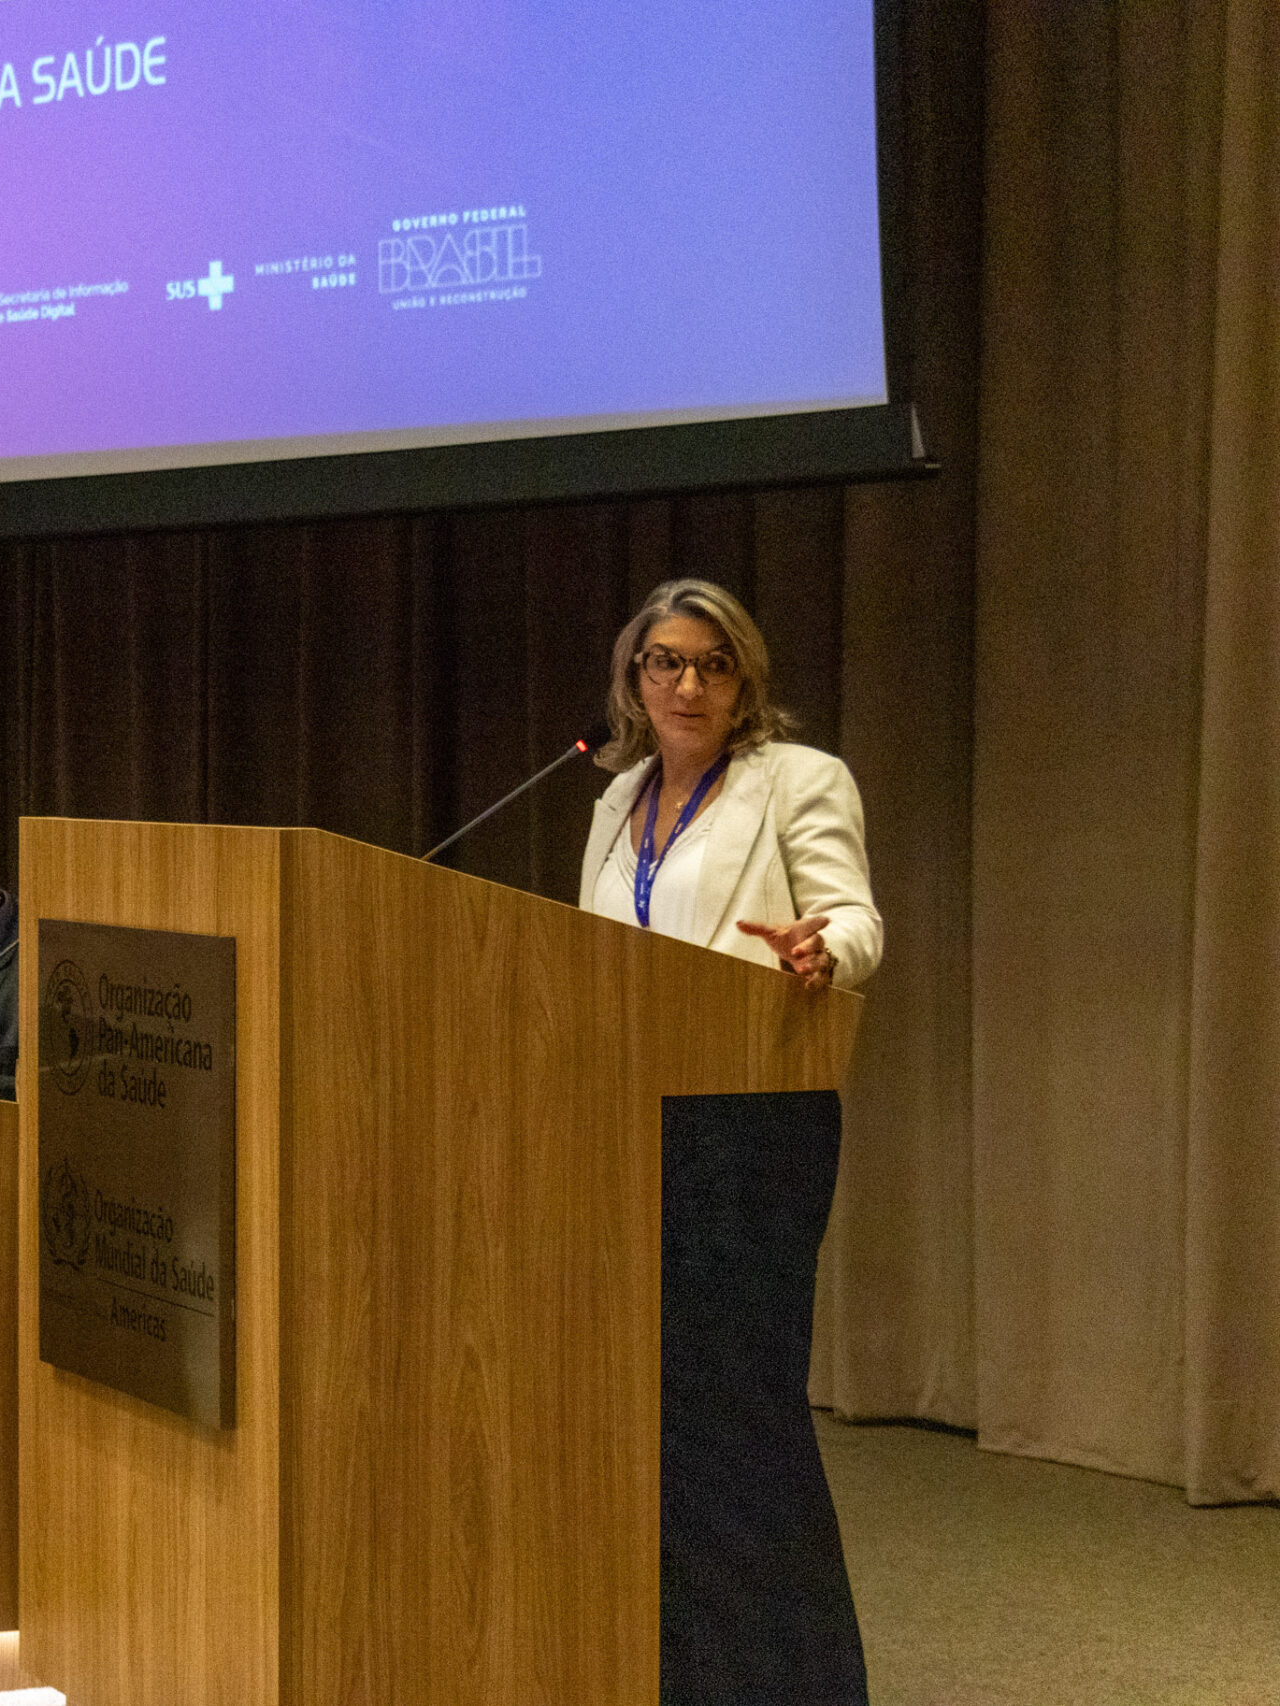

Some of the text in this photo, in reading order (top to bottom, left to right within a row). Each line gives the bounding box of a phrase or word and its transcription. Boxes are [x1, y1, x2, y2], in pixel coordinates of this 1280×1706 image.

[31, 35, 167, 105] SAÚDE
[392, 205, 526, 232] GOVERNO FEDERAL
[255, 253, 356, 275] MINISTÉRIO DA
[312, 272, 356, 290] SAÚDE
[378, 224, 542, 294] BRASIL
[40, 301, 75, 321] Digital
[52, 287, 67, 299] de
[166, 281, 196, 302] SUS
[98, 973, 192, 1022] Organização
[98, 1016, 213, 1071] Pan-Americana
[98, 1060, 167, 1109] da Saúde
[94, 1189, 174, 1243] Organização
[95, 1233, 214, 1302] Mundial da Saúde
